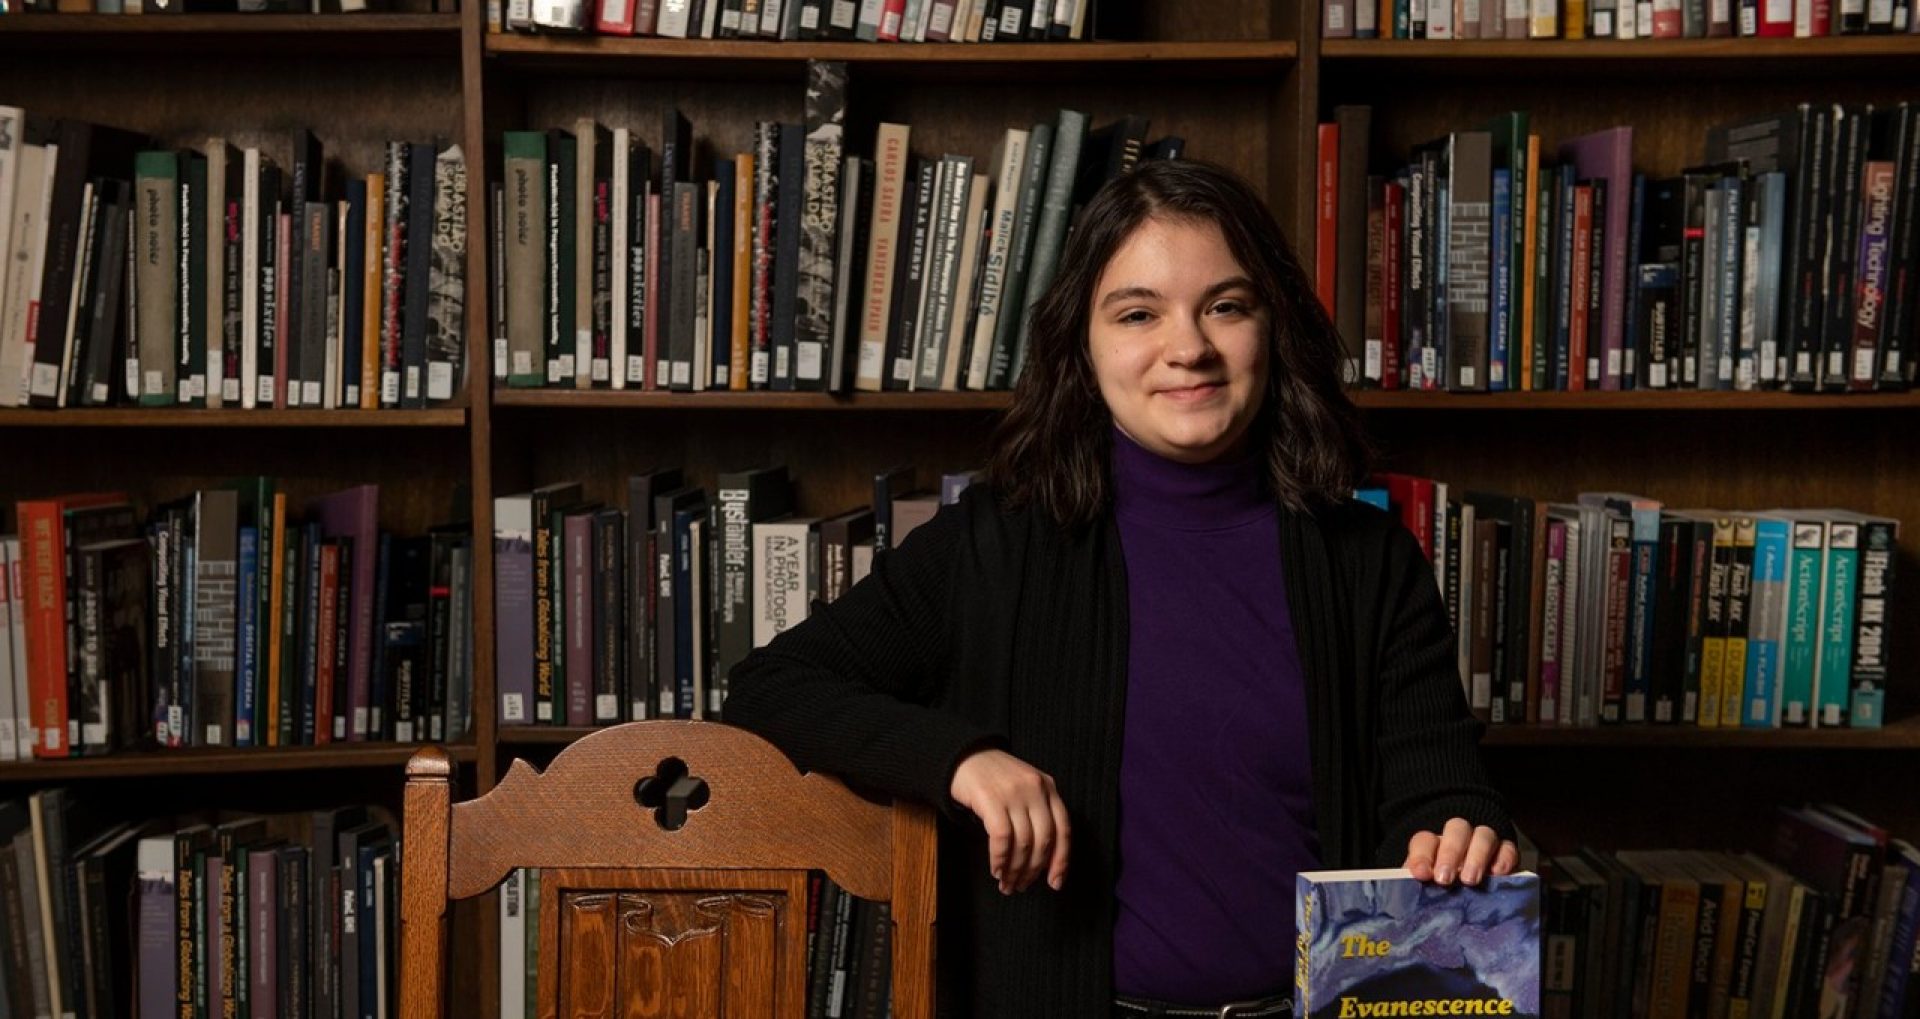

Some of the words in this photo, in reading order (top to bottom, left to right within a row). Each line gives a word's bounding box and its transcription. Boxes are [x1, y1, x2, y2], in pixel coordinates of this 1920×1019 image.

[883, 138, 899, 182] CARLOS
[519, 169, 532, 207] photo
[879, 184, 896, 223] SAURA
[1410, 173, 1422, 228] Compositing
[1728, 188, 1738, 214] FILM
[1866, 171, 1894, 235] Lighting
[147, 189, 160, 227] photo
[996, 209, 1014, 254] Malick
[1410, 230, 1422, 257] Visual
[1578, 230, 1587, 248] FILM
[1726, 216, 1737, 262] LIGHTING
[872, 237, 890, 294] VANISHED
[1410, 258, 1422, 290] Effects
[1576, 251, 1587, 311] RESTORATION
[1858, 239, 1886, 330] Technology
[978, 254, 1004, 316] Sidibé
[1498, 266, 1508, 307] DIGITAL
[1591, 269, 1601, 309] CINEMA
[868, 298, 884, 332] SPAIN
[1498, 311, 1507, 351] CINEMA
[1654, 302, 1666, 361] SUBTITLES
[36, 518, 49, 538] WE
[536, 528, 550, 558] Tales
[720, 489, 750, 571] Bystander:
[774, 536, 786, 552] IN
[788, 537, 798, 546] A
[37, 541, 52, 573] WENT
[538, 559, 550, 587] from
[764, 536, 772, 579] MAGNUM
[787, 550, 799, 592] YEAR
[1862, 557, 1888, 595] Flash
[38, 576, 54, 608] BACK
[538, 589, 548, 597] a
[1708, 563, 1726, 596] Flash
[1730, 562, 1746, 596] Flash
[85, 590, 97, 630] ABOUT
[157, 588, 168, 615] Visual
[764, 581, 772, 621] ARCHIVE
[1546, 562, 1560, 656] ACTIONSCRIPT
[1708, 600, 1721, 622] MX
[1729, 600, 1743, 622] MX
[1792, 555, 1813, 643] ActionScript
[1828, 555, 1849, 643] ActionScript
[1860, 598, 1885, 622] MX
[86, 634, 98, 650] TO
[158, 616, 168, 648] Effects
[244, 624, 254, 664] DIGITAL
[535, 598, 550, 660] Globalizing
[1856, 625, 1883, 666] 2004
[244, 669, 254, 708] CINEMA
[400, 660, 412, 719] SUBTITLES
[538, 662, 550, 697] World
[1756, 656, 1766, 696] FLASH
[180, 868, 192, 898] Tales
[222, 863, 235, 893] Tales
[180, 900, 192, 927] from
[223, 896, 235, 921] from
[1700, 898, 1716, 934] Avid
[1746, 910, 1760, 934] Final
[180, 930, 190, 938] a
[1341, 934, 1393, 959] The
[1744, 936, 1758, 957] Cut
[178, 938, 193, 1000] Globalizing
[1694, 936, 1714, 984] Uncut
[1338, 996, 1513, 1019] Evanescence
